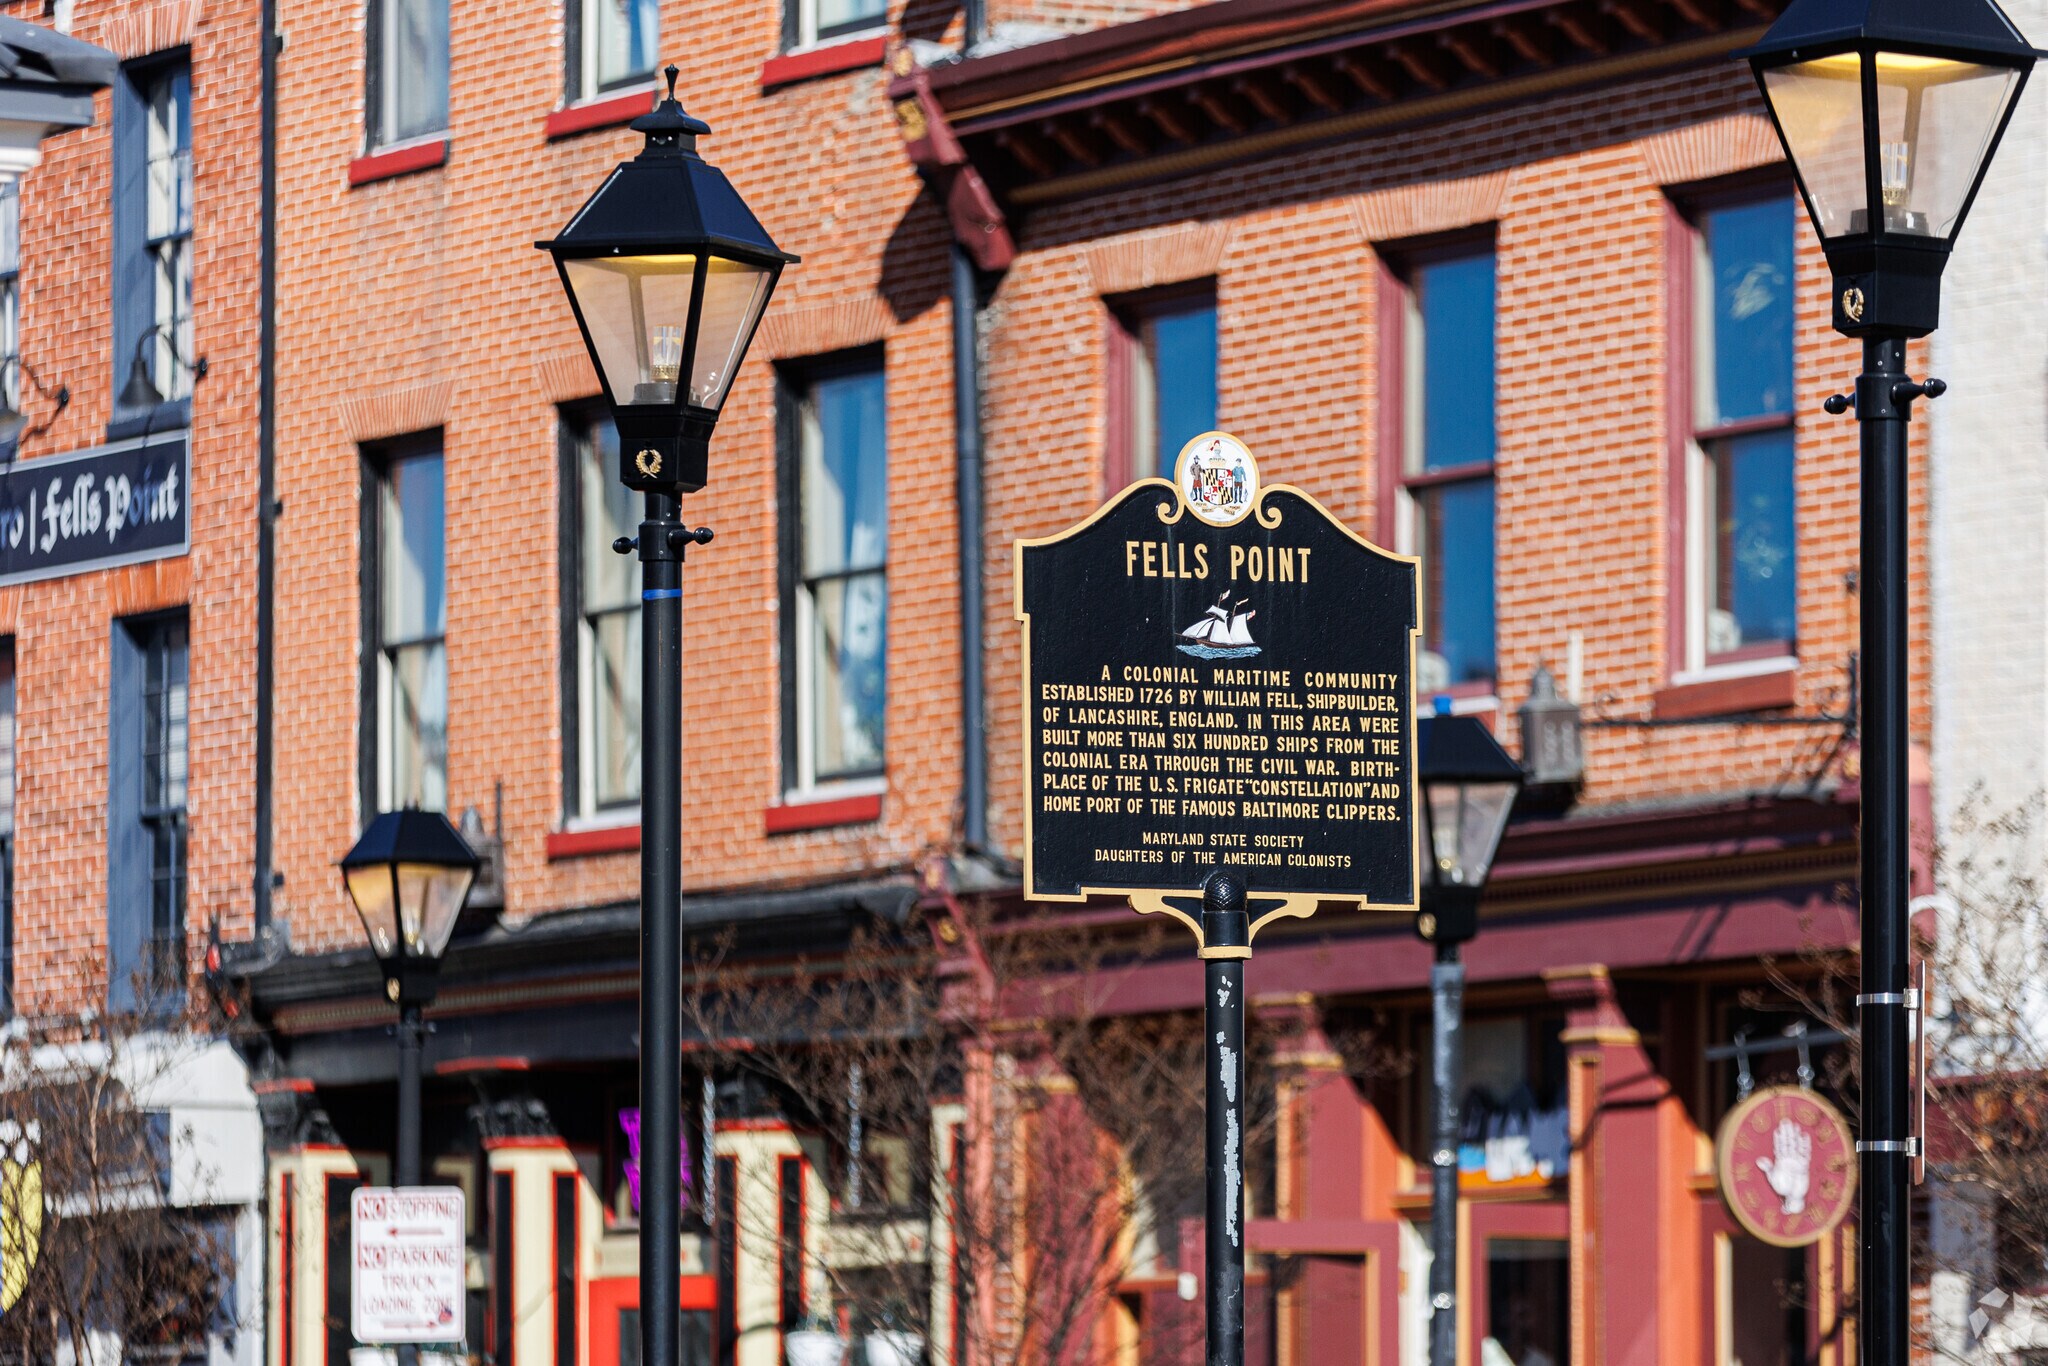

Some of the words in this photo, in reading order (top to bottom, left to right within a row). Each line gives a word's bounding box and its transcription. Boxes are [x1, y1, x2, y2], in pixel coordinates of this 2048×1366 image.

[105, 462, 180, 544] Point
[1126, 540, 1209, 580] FELLS
[1230, 544, 1311, 584] POINT
[1101, 664, 1111, 681] A
[1123, 665, 1199, 684] COLONIAL
[1213, 668, 1291, 687] MARITIME
[1304, 671, 1398, 690] COMMUNITY
[1042, 683, 1135, 703] ESTABLISHED
[1139, 687, 1173, 704] 1726
[1179, 688, 1197, 705] BY
[1202, 689, 1261, 707] WILLIAM
[1266, 691, 1304, 710] FELL,
[1306, 693, 1399, 713] SHIPBUILDER,
[1042, 706, 1061, 723] OF
[1068, 707, 1164, 729] LANCASHIRE,
[1169, 710, 1239, 729] ENGLAND.
[1247, 713, 1262, 730] IN
[1271, 714, 1304, 731] THIS
[1311, 715, 1351, 732] AREA
[1359, 716, 1400, 734] WERE
[1042, 728, 1081, 746] BUILT
[1087, 730, 1124, 747] MORE
[1128, 731, 1166, 749] THAN
[1172, 732, 1197, 750] SIX
[1203, 733, 1269, 752] HUNDRED
[1276, 735, 1319, 753] SHIPS
[1326, 737, 1365, 754] FROM
[1371, 738, 1400, 756] THE
[1042, 751, 1113, 769] COLONIAL
[1119, 753, 1149, 771] ERA
[1153, 754, 1220, 773] THROUGH
[1226, 756, 1254, 774] THE
[1260, 757, 1298, 775] CIVIL
[1304, 759, 1340, 776] WAR.
[1350, 760, 1400, 778] BIRTH-
[1043, 773, 1087, 791] PLACE
[1091, 774, 1109, 791] OF
[1115, 775, 1142, 792] THE
[1183, 777, 1245, 795] FRIGATE
[1370, 782, 1400, 799] AND
[1043, 795, 1082, 812] HOME
[1086, 796, 1122, 814] PORT
[1126, 797, 1144, 814] OF
[1149, 798, 1176, 815] THE
[1181, 799, 1236, 817] FAMOUS
[1242, 801, 1320, 819] BALTIMORE
[1326, 803, 1401, 822] CLIPPERS.
[1142, 831, 1204, 846] MARYLAND
[1210, 833, 1247, 847] STATE
[1254, 834, 1304, 848] SOCIETY
[1095, 848, 1164, 863] DAUGHTERS
[1171, 850, 1185, 864] OF
[1192, 851, 1216, 865] THE
[1223, 852, 1282, 866] AMERICAN
[1287, 853, 1351, 868] COLONISTS
[359, 1197, 386, 1219] NO
[359, 1247, 386, 1268] NO
[391, 1247, 458, 1267] PARKING
